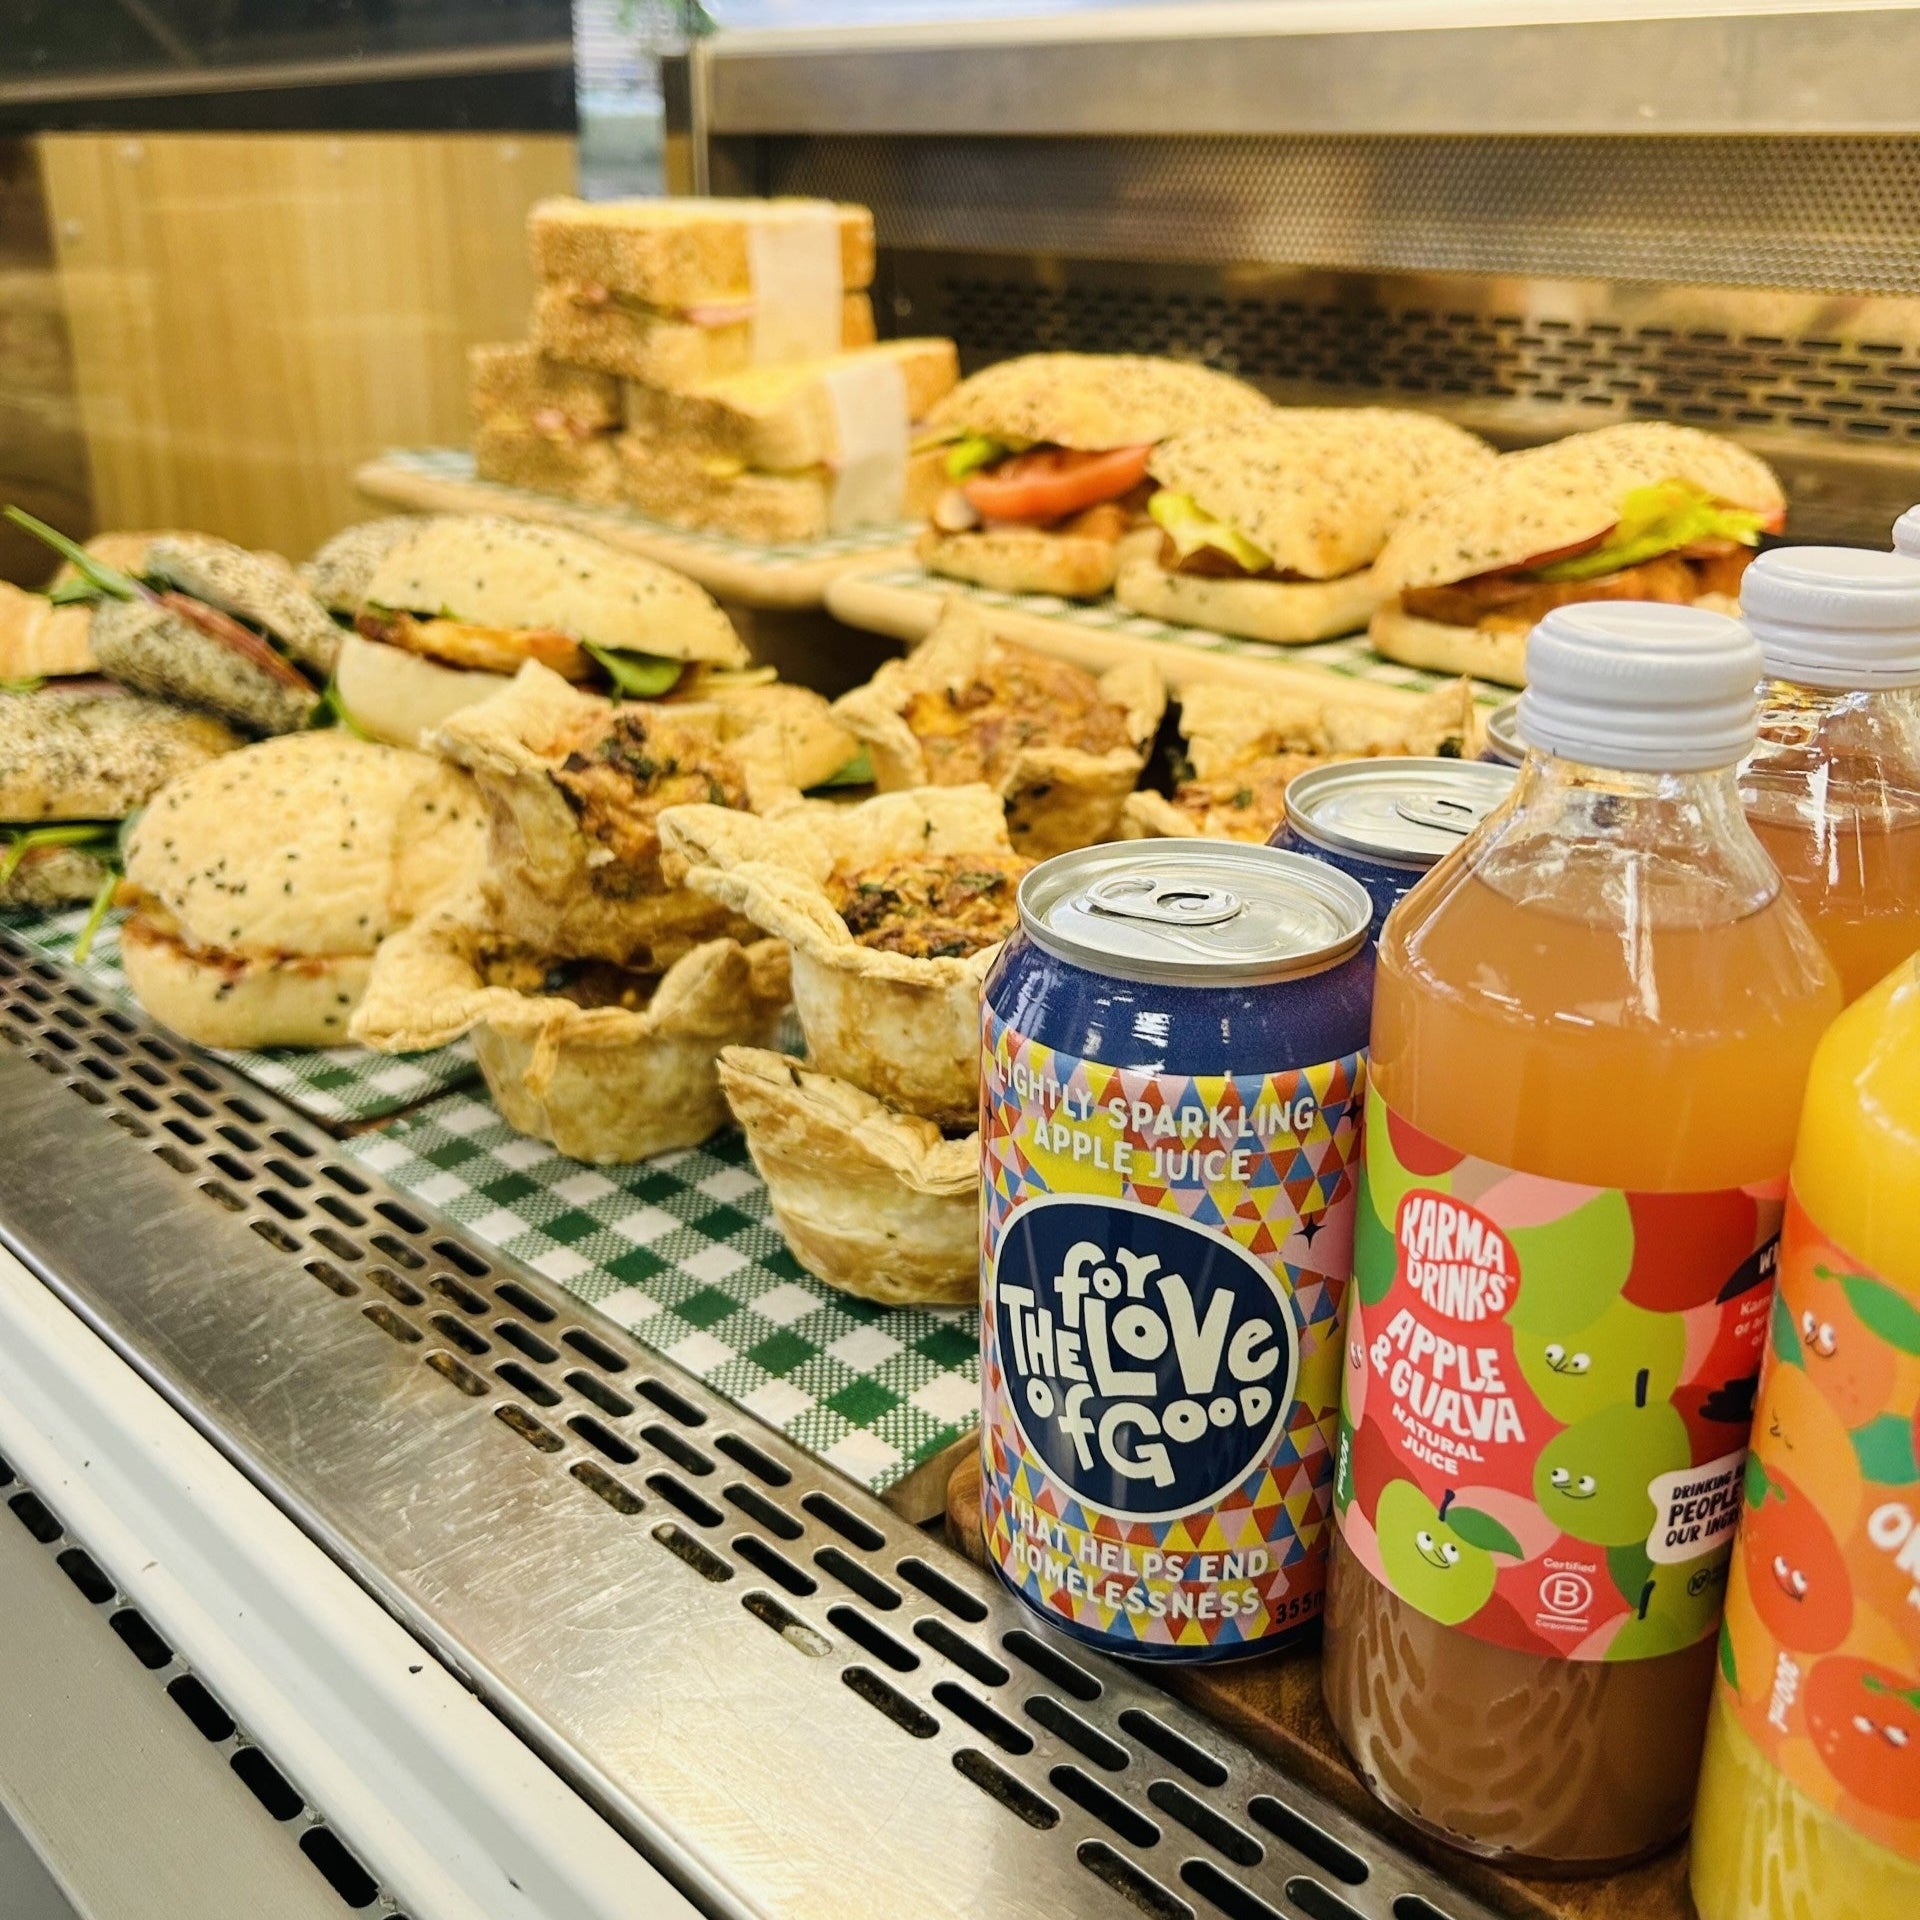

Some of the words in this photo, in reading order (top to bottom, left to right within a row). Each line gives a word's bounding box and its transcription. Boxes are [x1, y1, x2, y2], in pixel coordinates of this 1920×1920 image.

[997, 1048, 1092, 1121] LIGHTLY
[1108, 1096, 1314, 1138] SPARKLING
[1033, 1115, 1133, 1174] APPLE
[1148, 1148, 1252, 1181] JUICE
[1400, 1196, 1506, 1274] KARMA
[1053, 1240, 1162, 1328] for
[999, 1283, 1089, 1381] THE
[1385, 1307, 1506, 1394] APPLE
[1369, 1333, 1393, 1378] &
[1389, 1358, 1526, 1443] GUAVA
[1391, 1402, 1485, 1463] NATURAL
[1401, 1436, 1459, 1476] JUICE
[1671, 1470, 1733, 1501] DRINKING
[1009, 1490, 1067, 1553] THAT
[1079, 1533, 1185, 1583] HELPS
[1199, 1548, 1269, 1584] END
[1012, 1528, 1260, 1619] HOMELESSNESS
[1542, 1556, 1597, 1574] Certified
[1665, 1524, 1701, 1547] OUR
